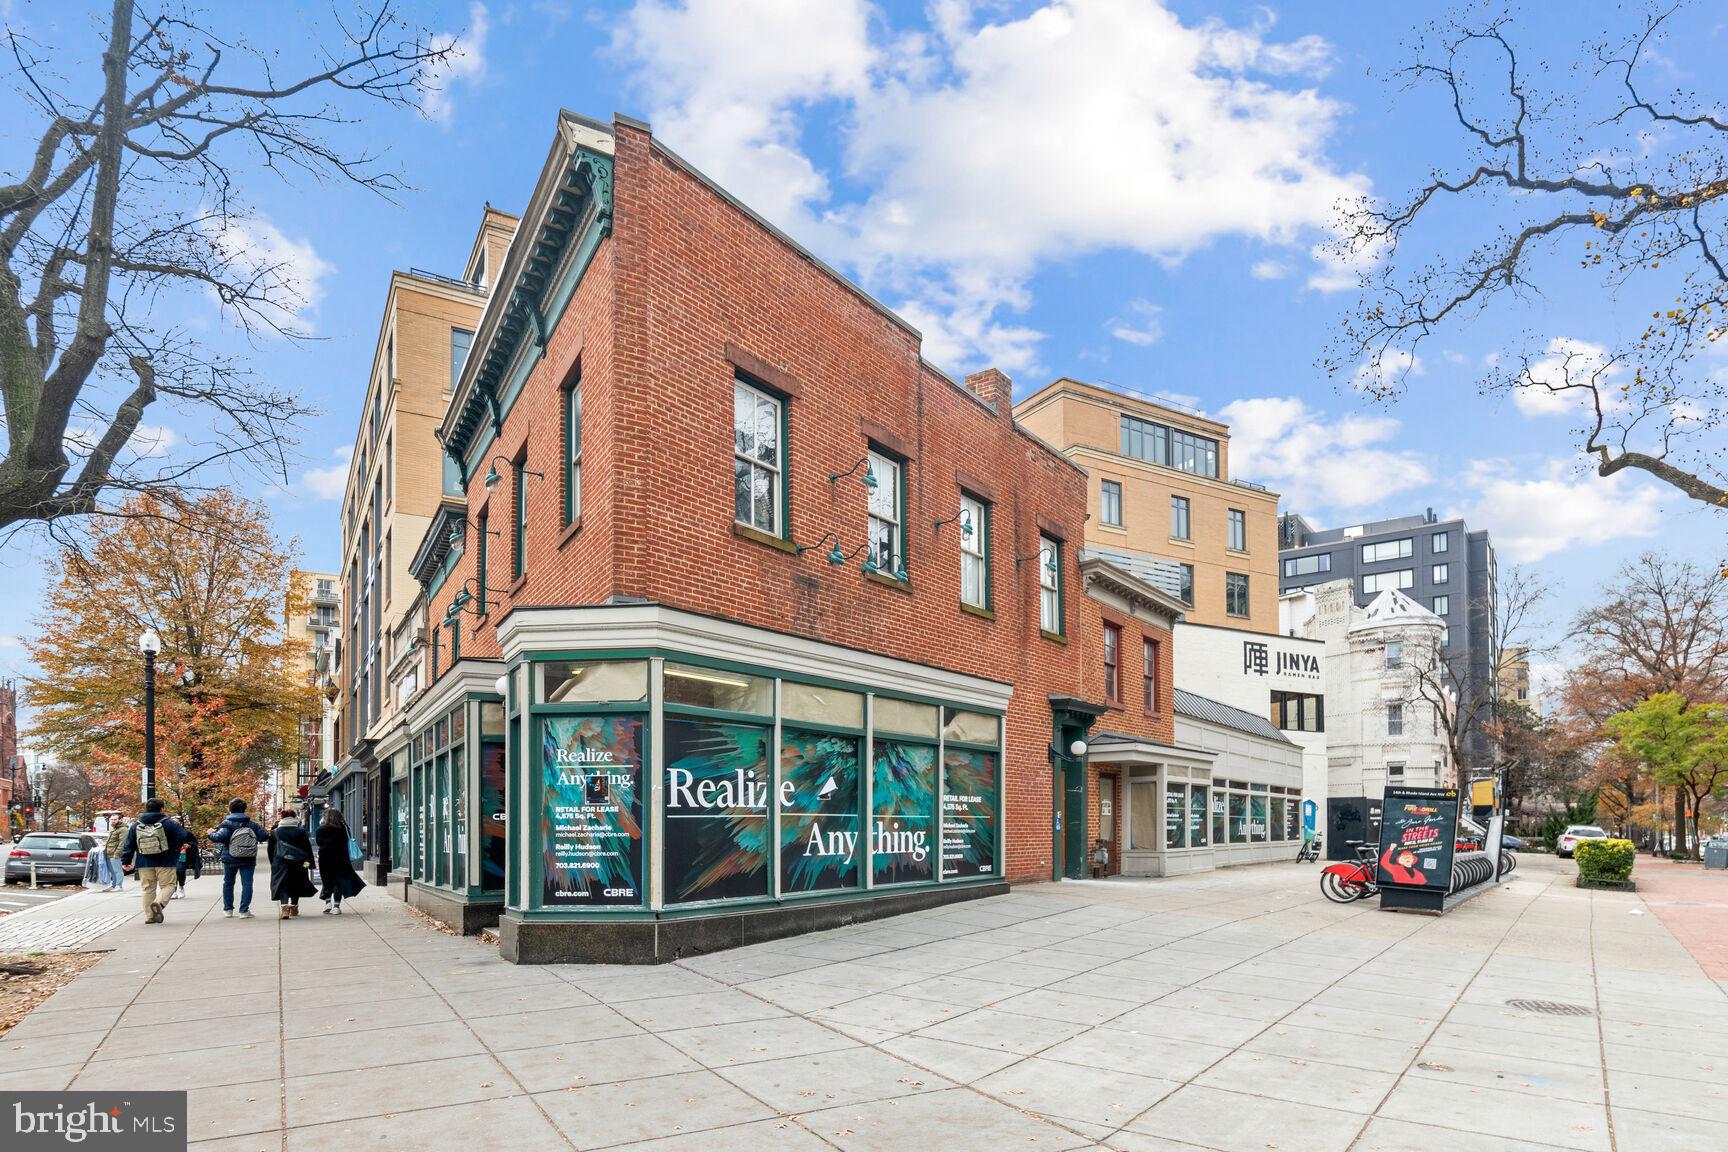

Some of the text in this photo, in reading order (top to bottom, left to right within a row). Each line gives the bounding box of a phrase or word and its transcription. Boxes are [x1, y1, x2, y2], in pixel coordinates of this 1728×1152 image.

[1276, 651, 1320, 675] JINYA
[556, 747, 613, 763] Realize
[556, 771, 634, 791] Anying.
[666, 767, 796, 809] Realize
[1401, 828, 1440, 843] STREETS
[603, 888, 634, 897] CBRE
